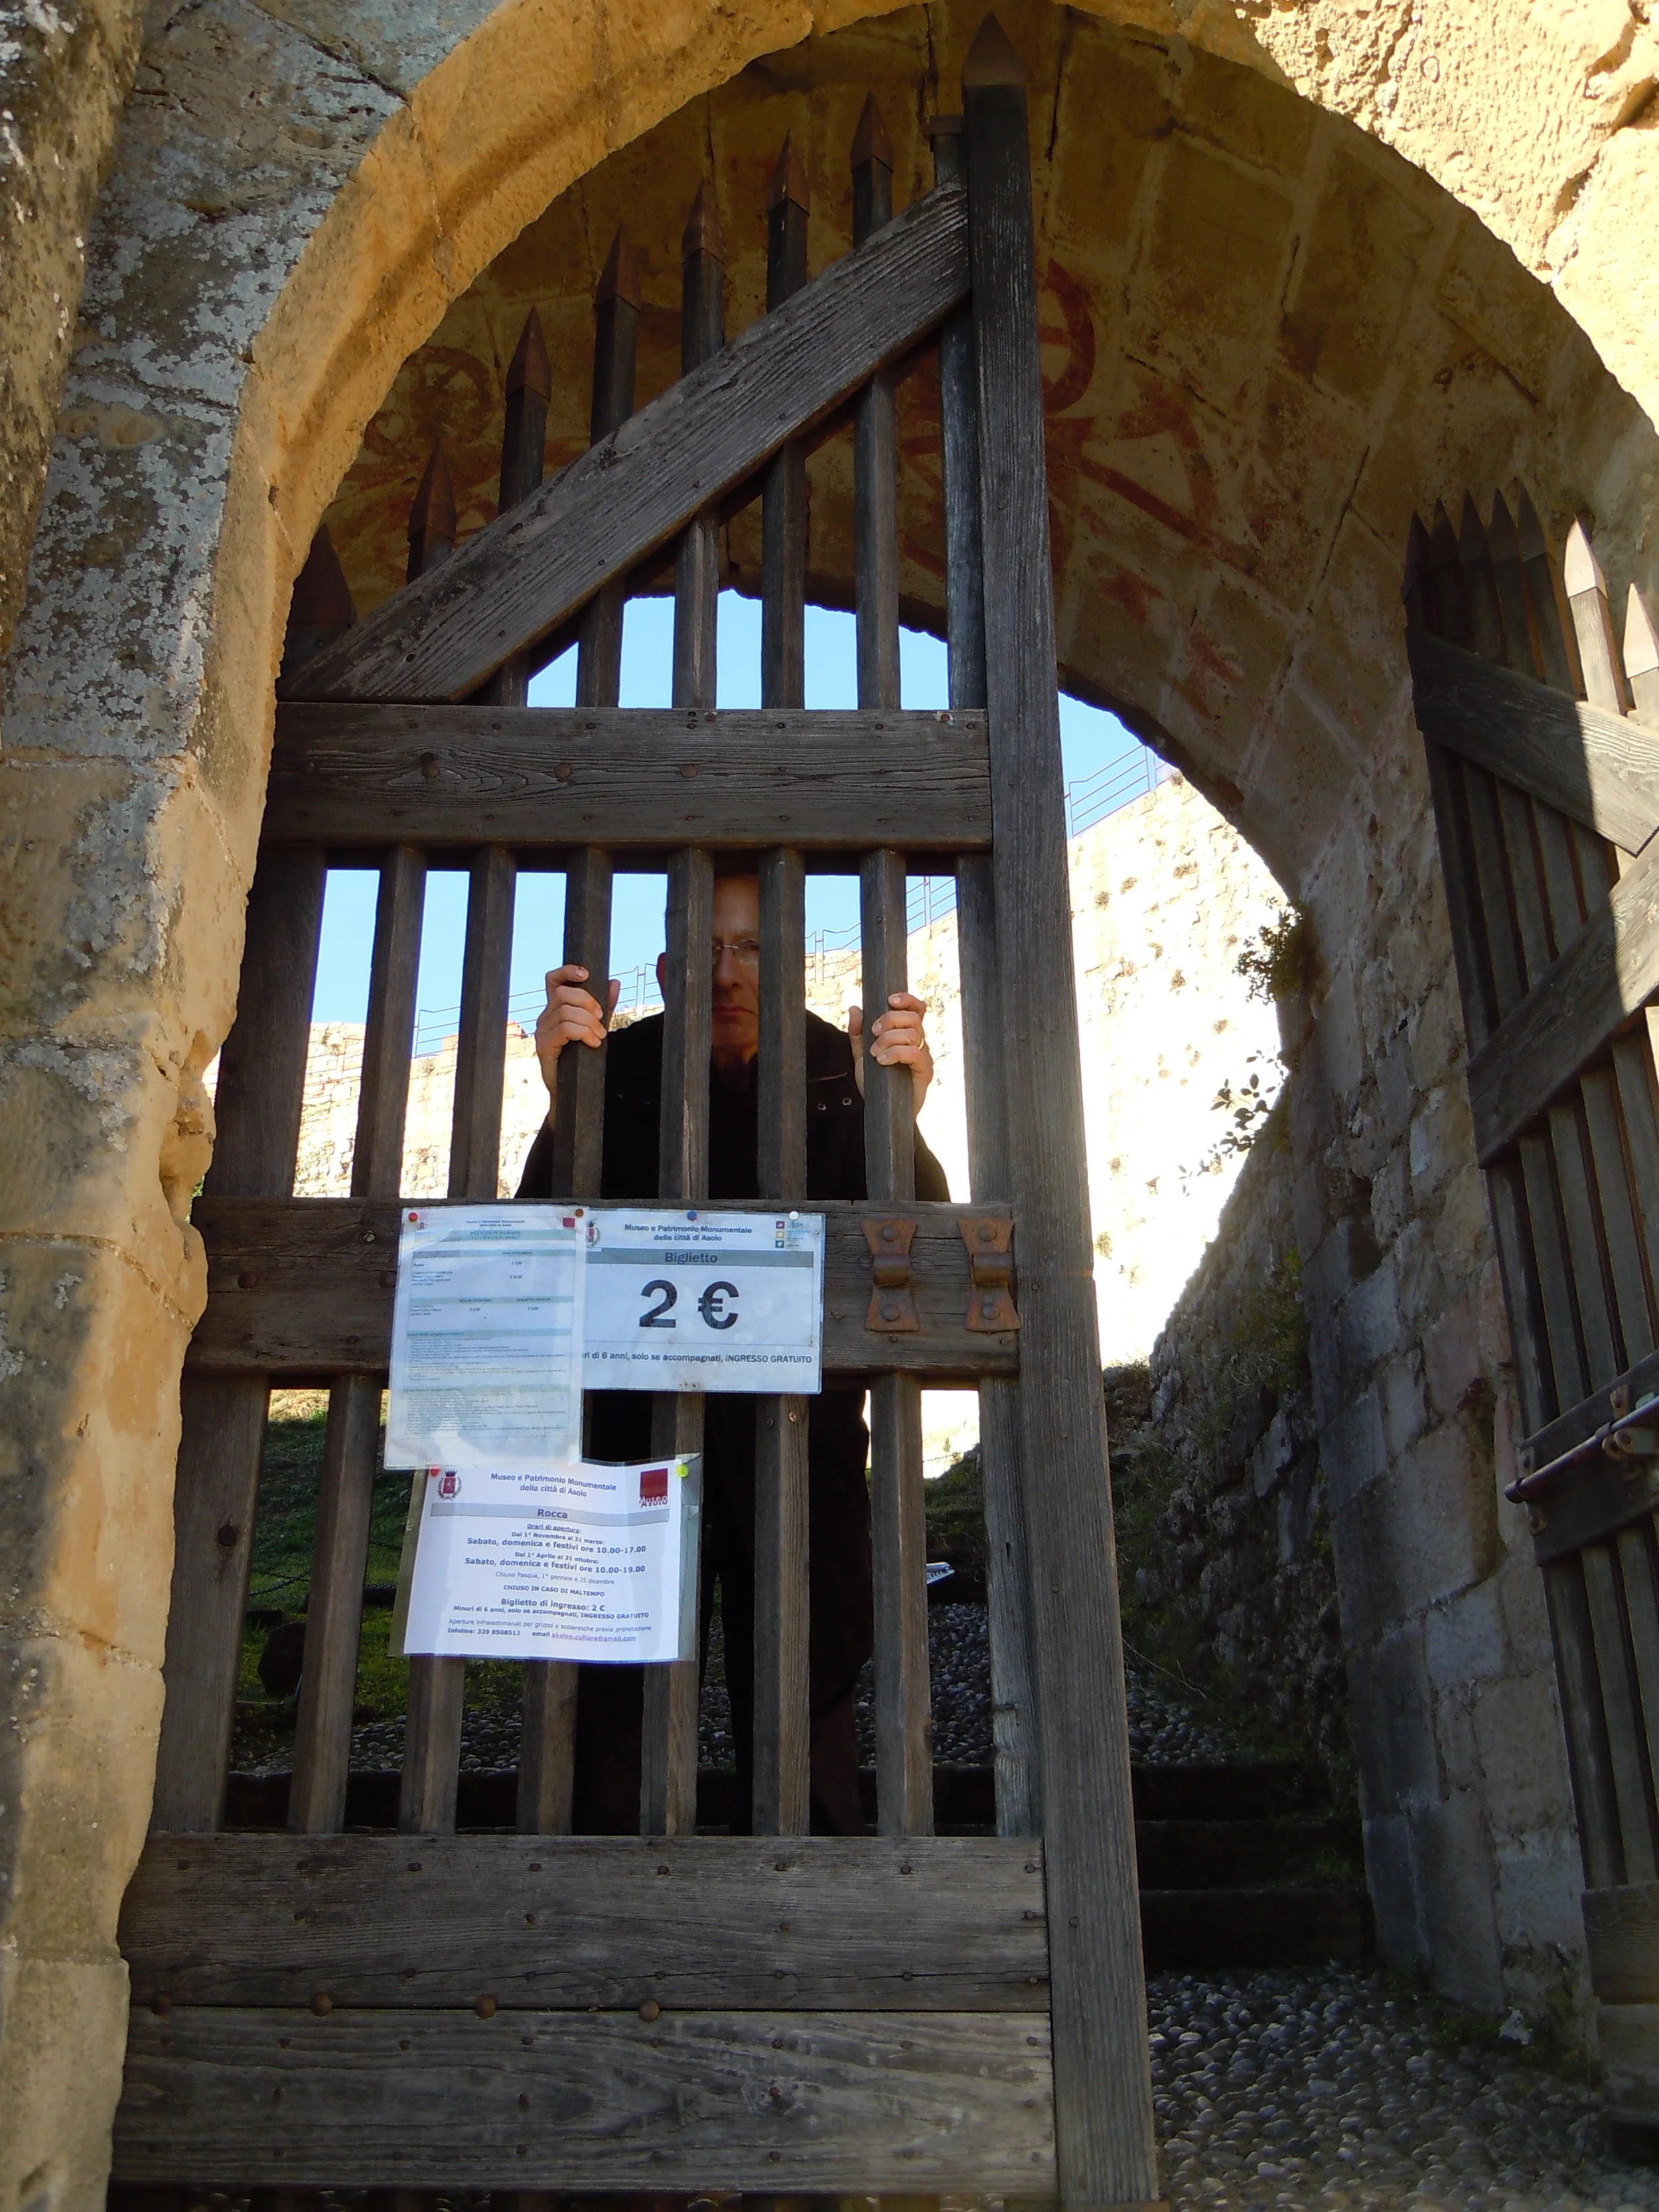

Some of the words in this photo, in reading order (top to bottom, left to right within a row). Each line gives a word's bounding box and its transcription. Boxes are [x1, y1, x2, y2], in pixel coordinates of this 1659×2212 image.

[665, 1252, 718, 1265] Biglietto
[639, 1280, 678, 1328] 2
[697, 1280, 739, 1330] €
[609, 1353, 630, 1361] anni,
[663, 1353, 723, 1363] accompagnati,
[770, 1355, 812, 1364] GRATUITO
[524, 1473, 566, 1484] Patrimonio
[567, 1478, 616, 1491] Monumentale
[540, 1484, 557, 1493] città
[567, 1489, 587, 1497] Asolo
[537, 1509, 568, 1519] Rocca
[467, 1537, 499, 1546] Sabato,
[502, 1538, 543, 1547] domenica
[553, 1541, 578, 1550] festivi
[597, 1545, 646, 1554] 10.00-17.00
[465, 1558, 496, 1566] Sabato,
[500, 1558, 541, 1567] domenica
[551, 1561, 577, 1570] festivi
[595, 1565, 645, 1574] 10.00-19.00
[501, 1598, 538, 1607] Biglietto
[550, 1600, 589, 1611] ingresso:
[532, 1609, 579, 1618] accompagnati,
